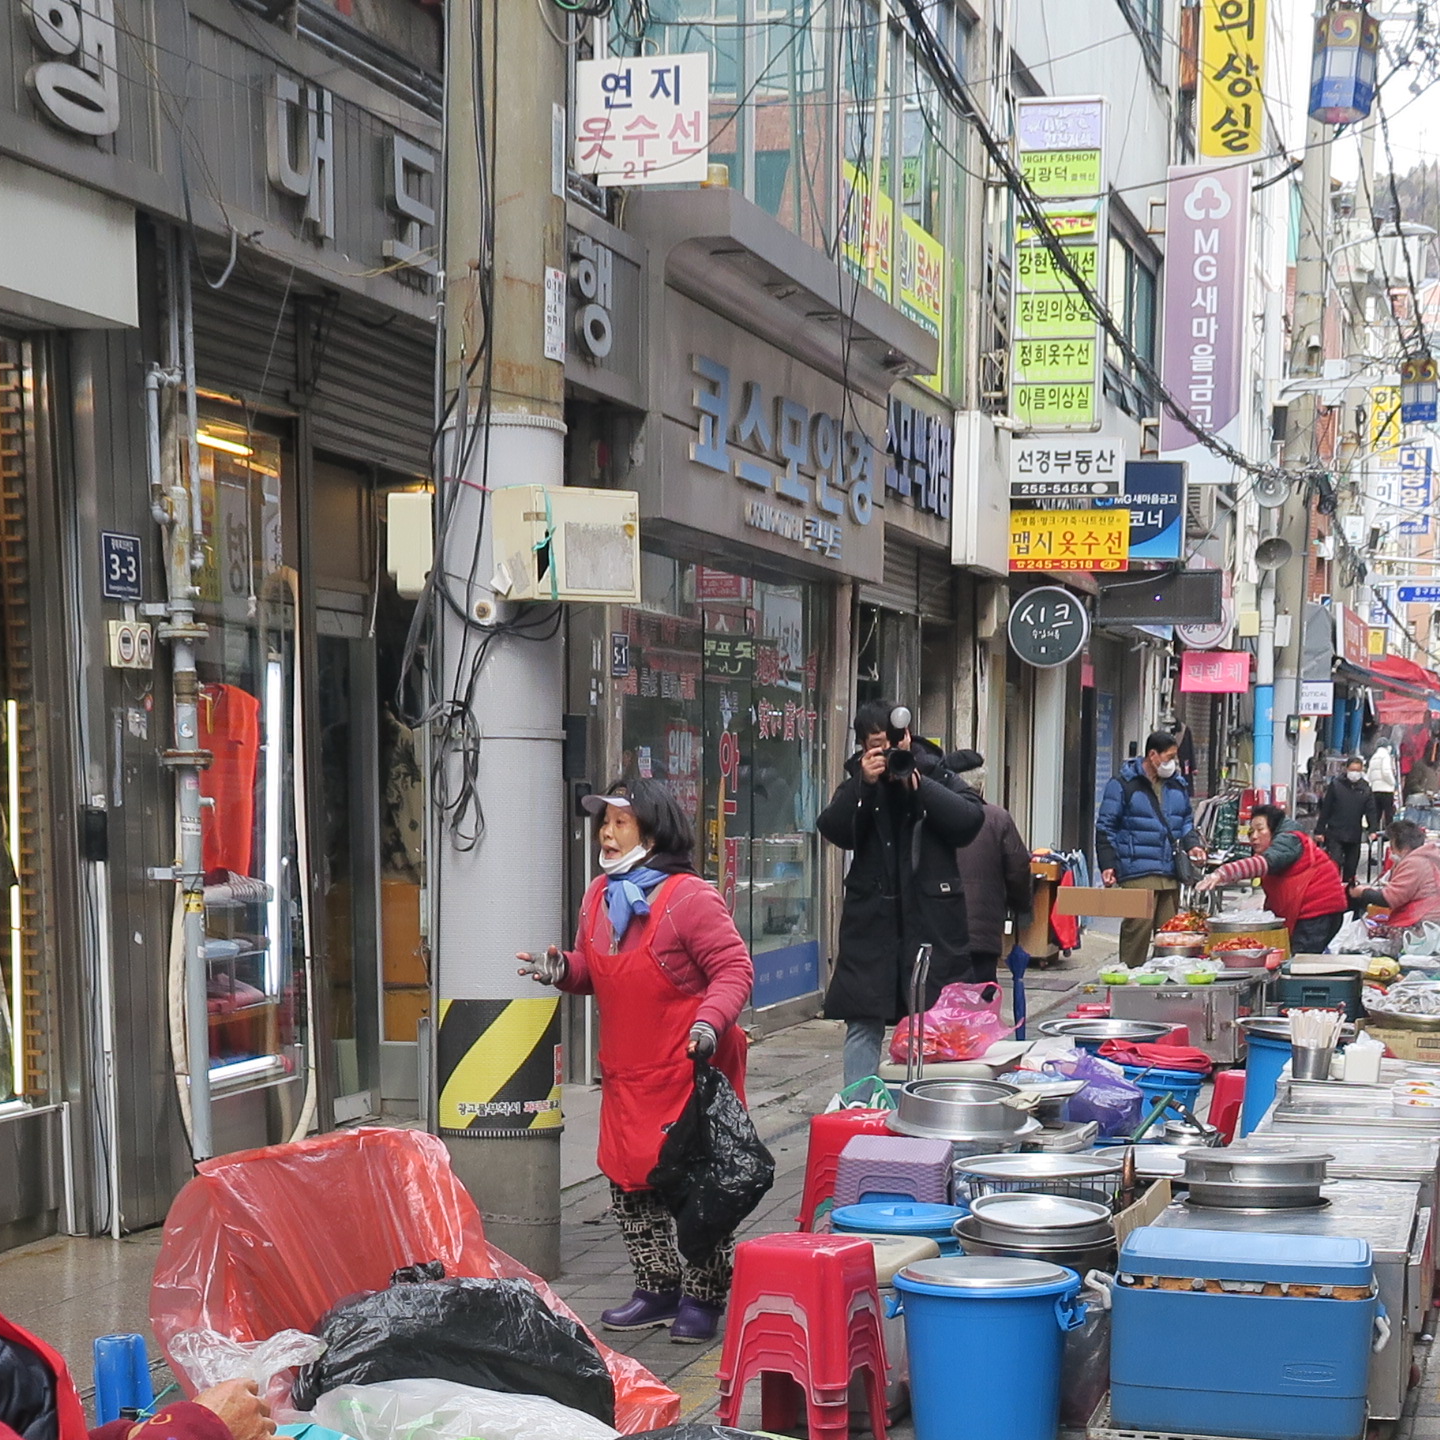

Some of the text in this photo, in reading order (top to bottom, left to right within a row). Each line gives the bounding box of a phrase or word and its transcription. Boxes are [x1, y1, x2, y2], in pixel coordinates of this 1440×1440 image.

[600, 64, 681, 109] 연지
[1209, 0, 1260, 153] 의상실
[577, 110, 703, 161] 옷수선
[622, 160, 658, 179] 2F
[1022, 153, 1097, 163] HIGH FASHION
[1023, 165, 1068, 183] 김광덕
[689, 353, 874, 527] 코스모안경
[1017, 449, 1116, 476] 선경부동산
[1020, 484, 1088, 495] 255-5454
[1012, 530, 1123, 556] 맵시 옷수선
[110, 553, 137, 583] 3-3
[1027, 559, 1094, 570] 245-3518
[1019, 603, 1074, 628] 시크
[613, 645, 628, 665] 5-1
[1187, 661, 1244, 683] 피렌체
